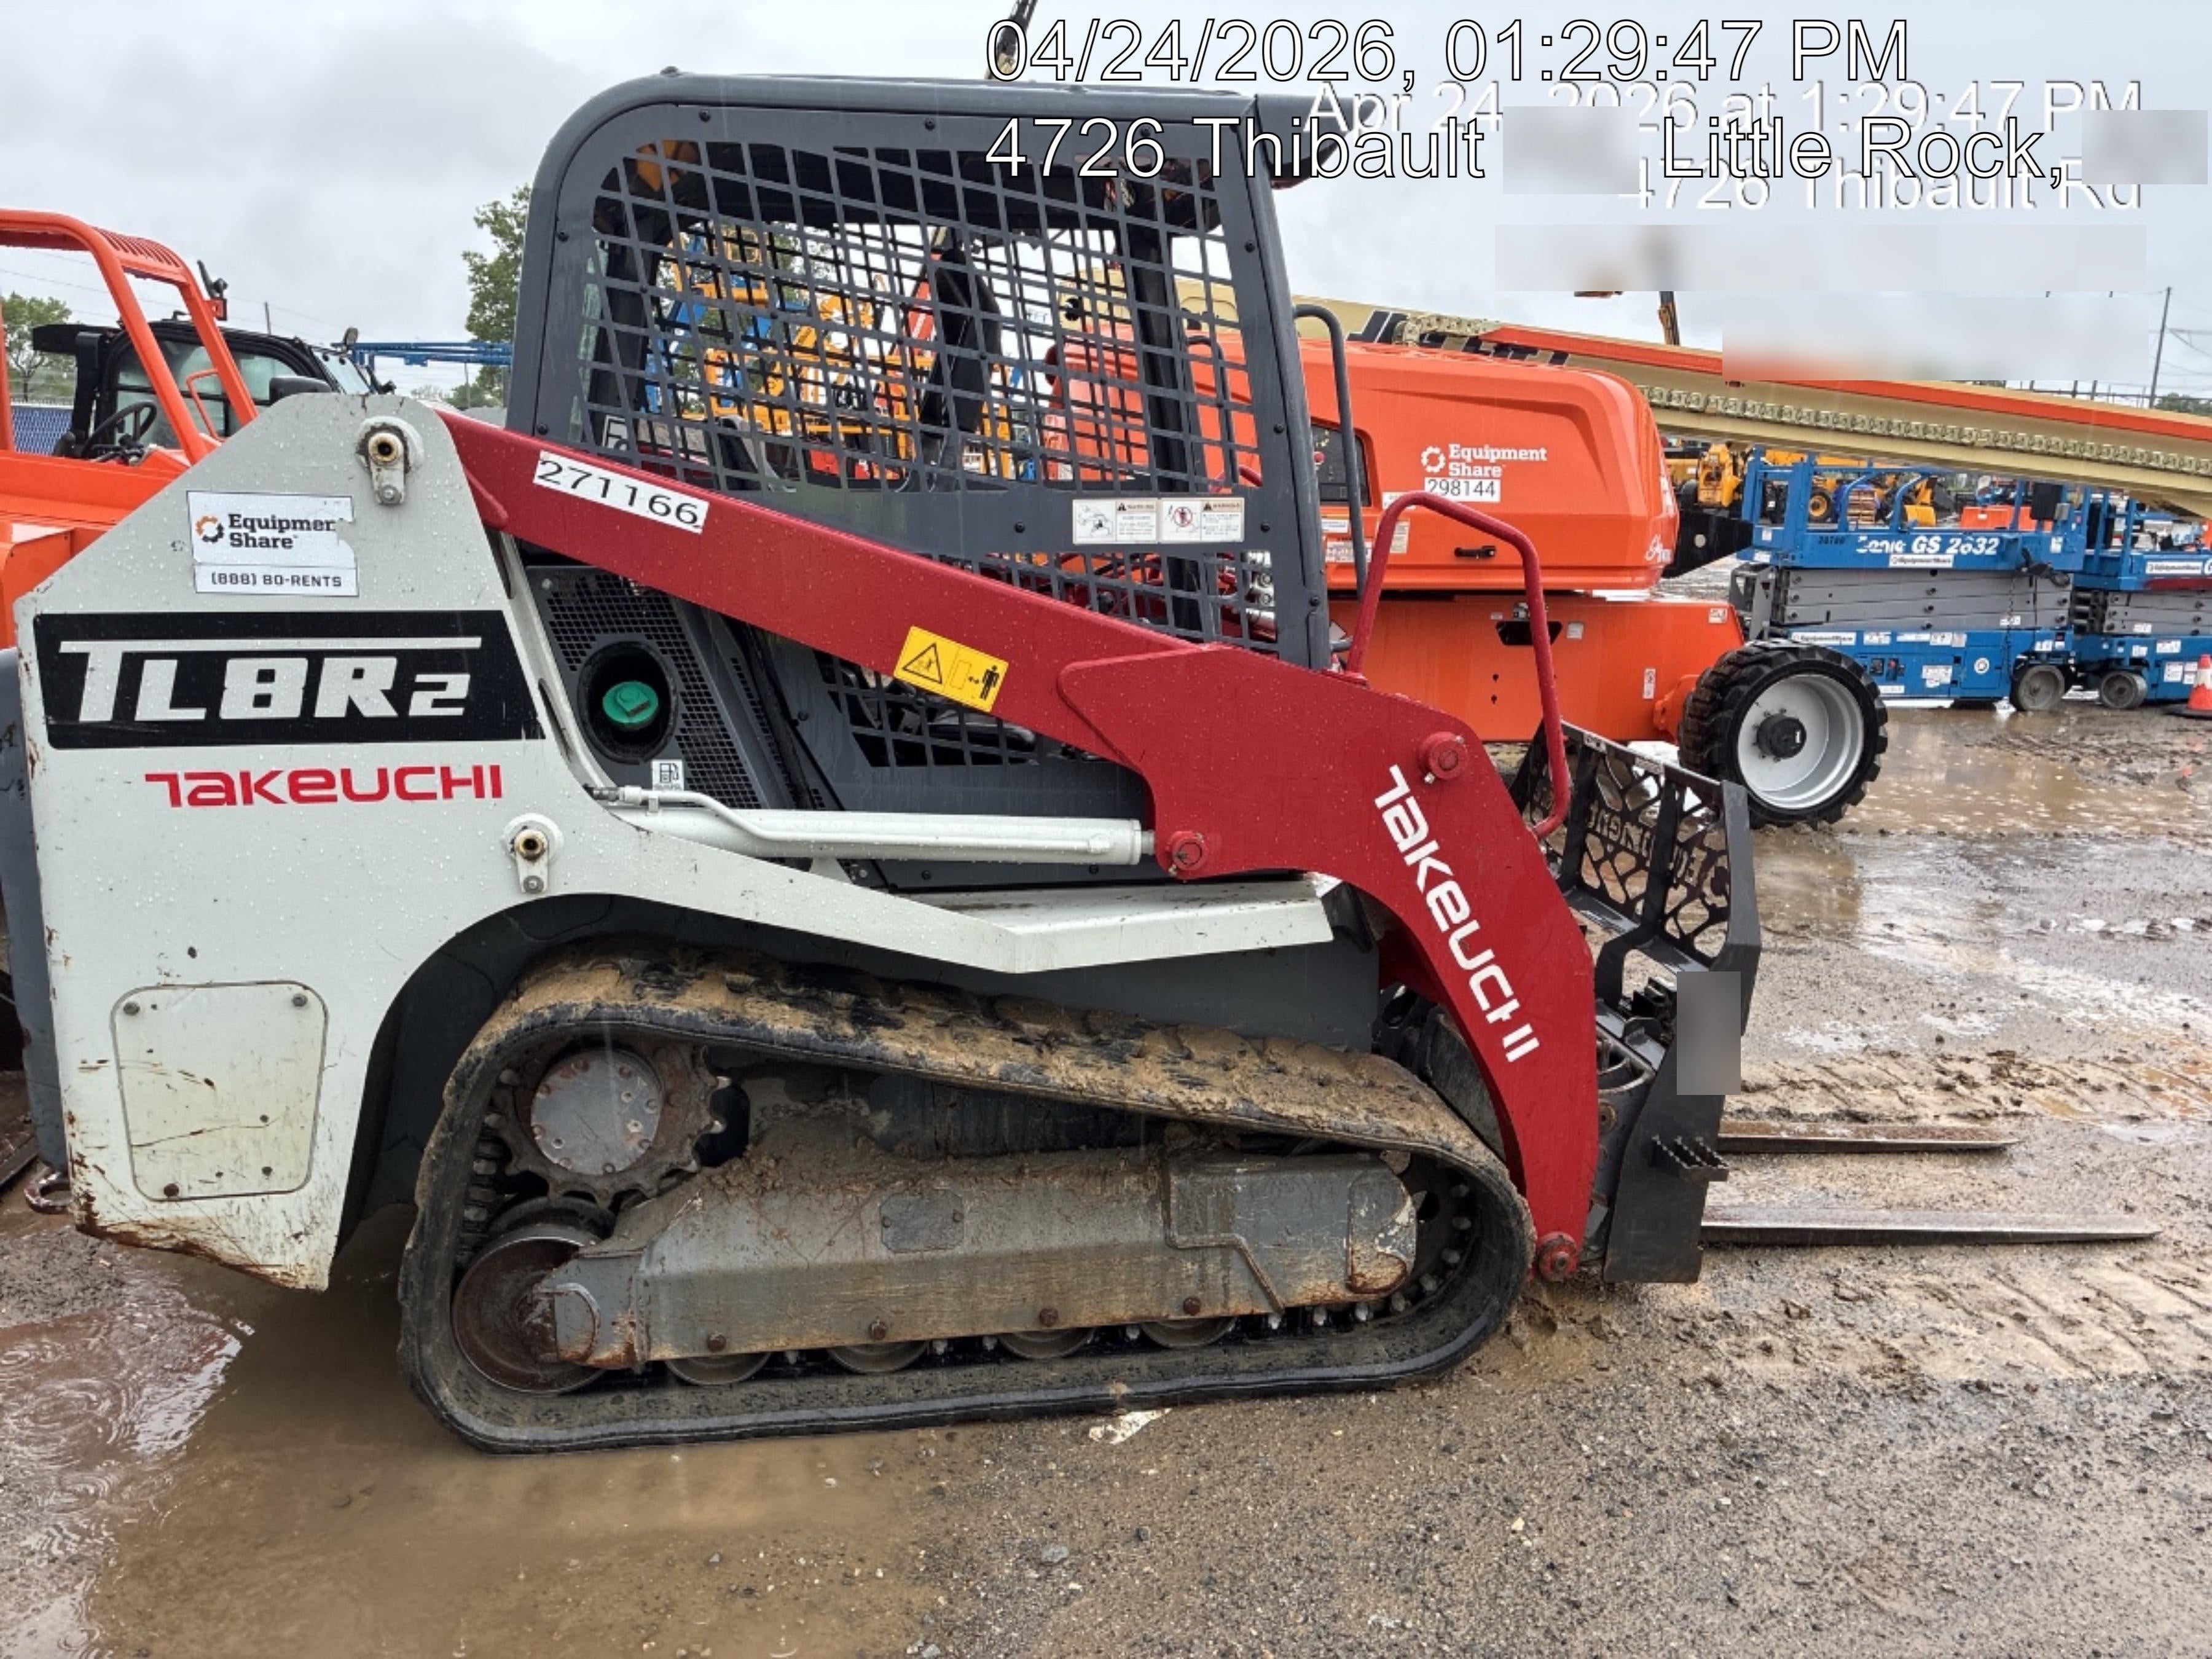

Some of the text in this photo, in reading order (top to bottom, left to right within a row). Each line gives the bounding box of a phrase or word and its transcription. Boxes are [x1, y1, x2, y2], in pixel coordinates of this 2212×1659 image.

[1448, 443, 1548, 463] Equipment
[1448, 462, 1503, 477] Share
[536, 460, 701, 525] 271166
[1428, 479, 1496, 496] 298144
[1911, 536, 1942, 554] GS
